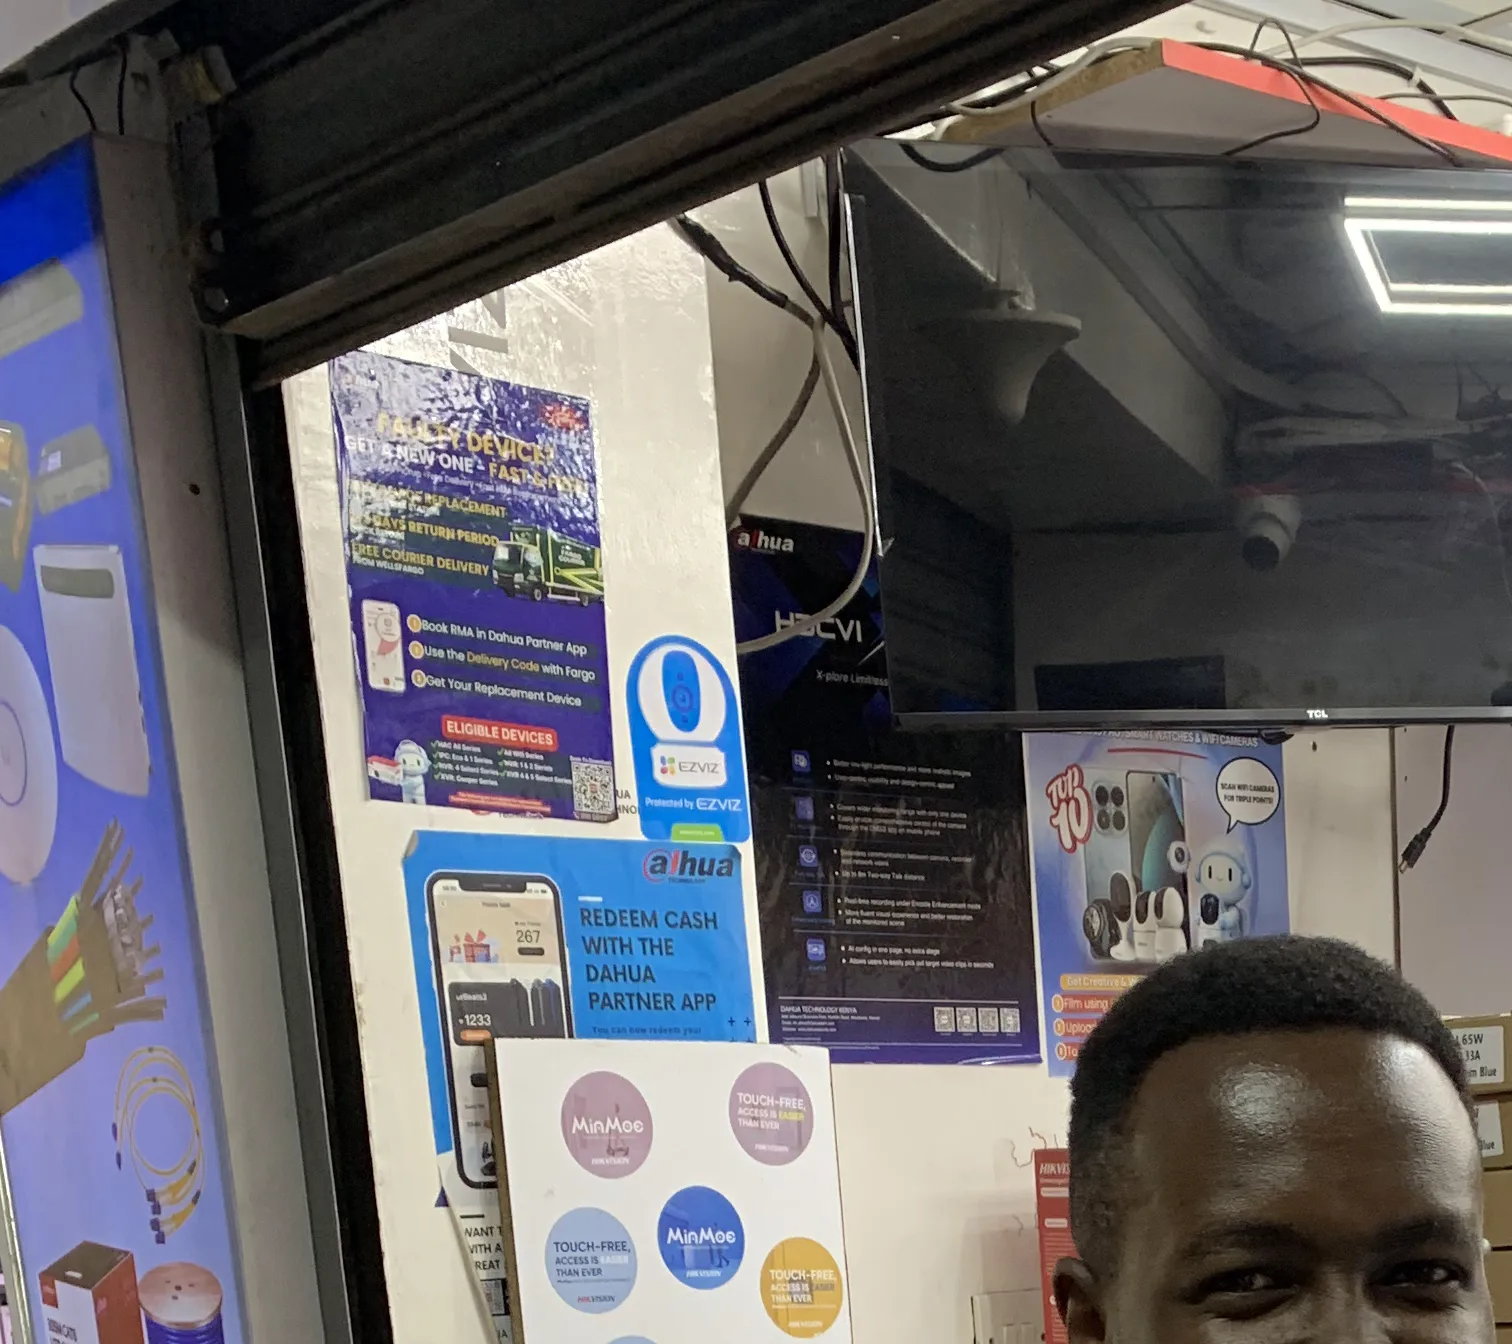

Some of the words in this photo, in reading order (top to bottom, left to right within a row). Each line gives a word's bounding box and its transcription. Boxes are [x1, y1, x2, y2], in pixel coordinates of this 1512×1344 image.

[397, 447, 437, 465] NEW
[439, 455, 473, 473] ONE
[489, 463, 529, 484] FAST
[425, 493, 507, 518] REPLACEMENT
[408, 522, 454, 540] RETURN
[456, 529, 499, 548] PERIOD
[382, 549, 434, 567] COURIER
[437, 557, 489, 577] DELIVERY
[422, 620, 449, 635] Book
[450, 623, 474, 639] RMA
[476, 627, 486, 640] in
[489, 630, 523, 646] Dahua
[526, 634, 564, 652] Partner
[566, 642, 587, 657] App
[425, 646, 444, 658] Use
[447, 649, 465, 661] the
[467, 652, 509, 670] Delivery
[512, 658, 540, 672] Code
[542, 663, 563, 676] with
[566, 667, 595, 682] Fargo
[816, 669, 848, 683] X-plore
[426, 675, 446, 688] Get
[448, 678, 472, 692] Your
[475, 681, 544, 702] Replacement
[547, 693, 581, 707] Device
[1307, 710, 1328, 719] TCL
[447, 721, 499, 739] ELIGIBLE
[502, 728, 553, 746] DEVICES
[1154, 731, 1193, 743] WATCHES
[1195, 733, 1201, 744] &
[1201, 733, 1218, 745] WIFI
[1219, 735, 1258, 748] CAMERAS
[679, 761, 720, 774] EZVIZ
[646, 798, 682, 809] Protected
[683, 798, 694, 812] by
[696, 799, 741, 812] EZVIZ
[580, 908, 658, 929] REDEEM
[664, 911, 718, 930] CASH
[516, 930, 541, 944] 267
[581, 935, 634, 956] WITH
[639, 937, 675, 957] THE
[586, 964, 656, 984] DAHUA
[589, 992, 676, 1012] PARTNER
[681, 993, 717, 1012] APP
[465, 1014, 491, 1027] 1233
[572, 1116, 644, 1135] MinMoe
[667, 1227, 736, 1245] MinMoe
[553, 1241, 632, 1253] TOUCH-FREE,
[555, 1256, 588, 1266] ACCESS
[590, 1255, 599, 1265] IS
[557, 1267, 579, 1278] THAN
[581, 1267, 602, 1278] EVER
[577, 1295, 616, 1304] HIKVISION
